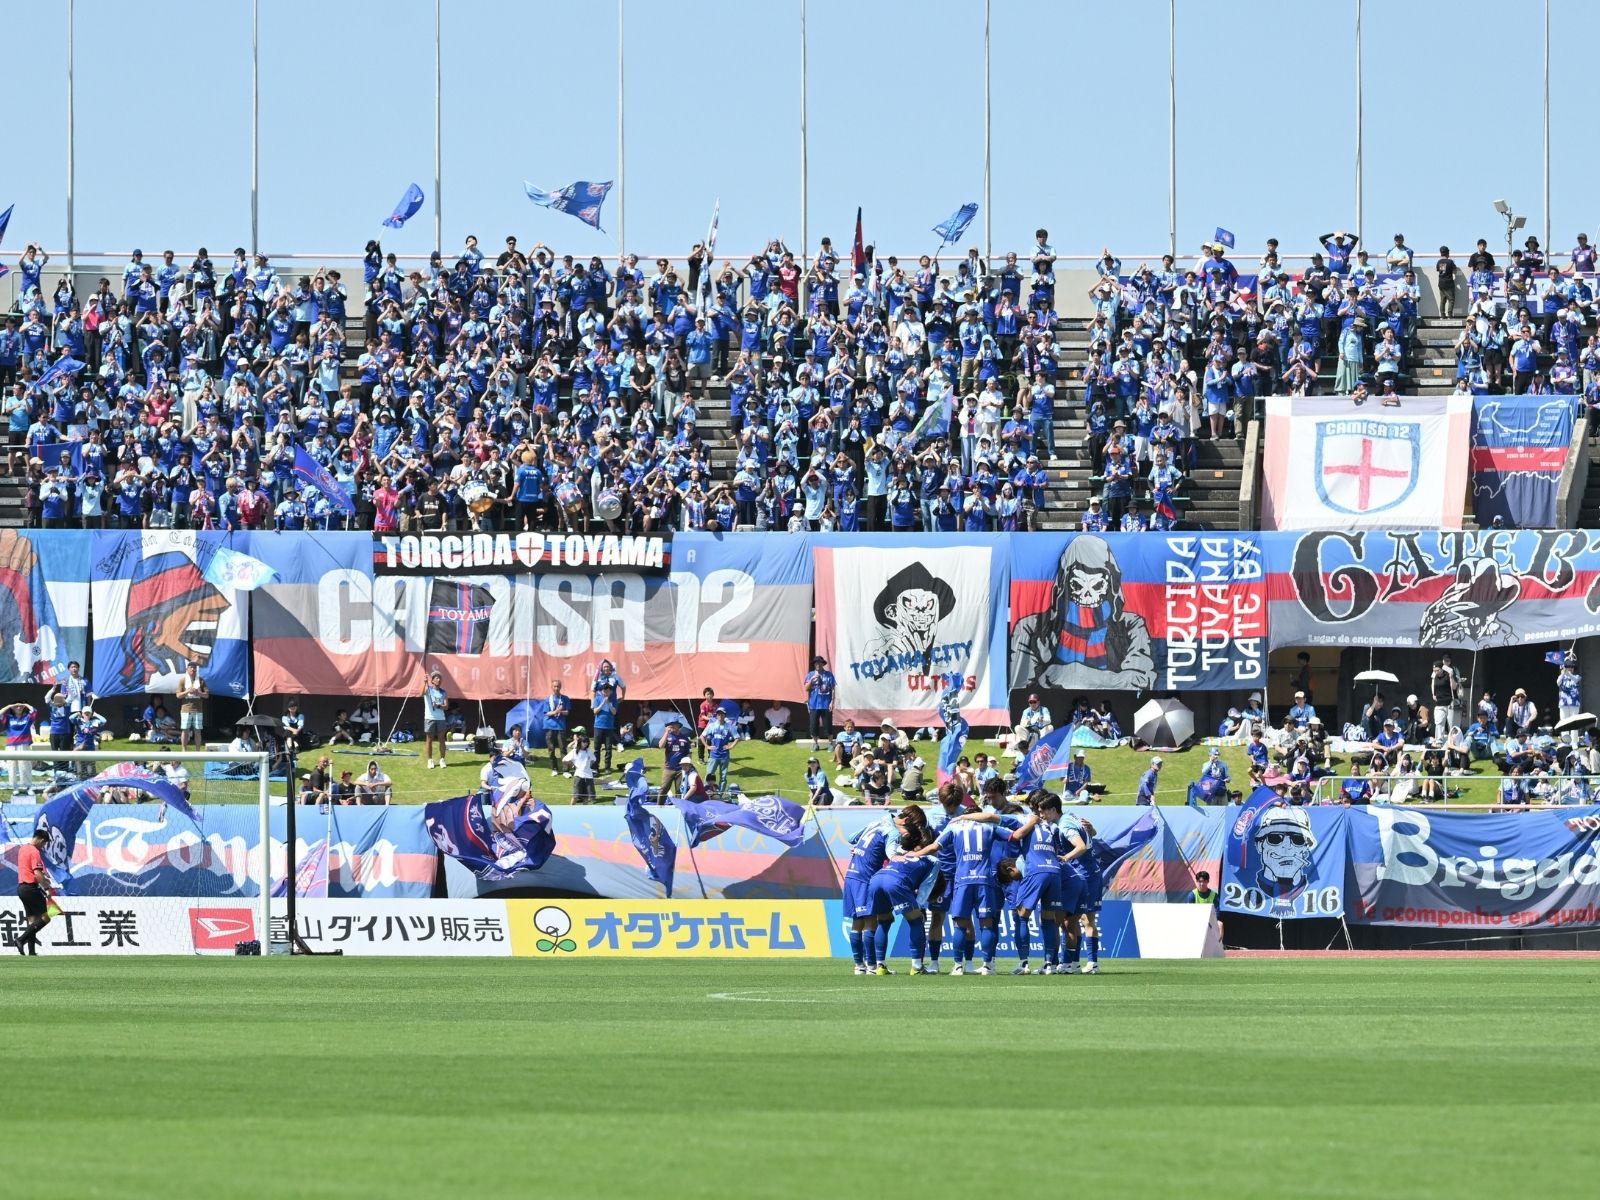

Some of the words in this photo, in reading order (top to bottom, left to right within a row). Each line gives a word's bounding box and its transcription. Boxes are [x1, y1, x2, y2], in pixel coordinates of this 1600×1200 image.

[1326, 422, 1387, 438] CAMISA
[1392, 425, 1410, 438] 12
[382, 534, 514, 569] TORCIDA
[547, 535, 664, 569] TOYAMA
[1233, 538, 1262, 580] B7
[1289, 530, 1522, 625] GATE
[1516, 529, 1600, 614] B
[438, 608, 490, 621] TOYAMA
[667, 568, 756, 655] 12
[1166, 536, 1198, 690] TORCIDA
[1201, 538, 1229, 671] TOYAMA
[1233, 593, 1262, 680] GATE
[563, 664, 640, 677] 206
[849, 650, 927, 681] TOYAMA
[930, 640, 973, 664] CITY
[907, 674, 977, 692] ULTS
[963, 825, 983, 852] 11
[1224, 882, 1266, 912] 20
[1302, 885, 1343, 915] 16
[1382, 903, 1503, 927] acompanho
[1508, 911, 1541, 925] em
[270, 916, 504, 943] 富山ダイハツ販売
[584, 911, 806, 950] オダケホーム
